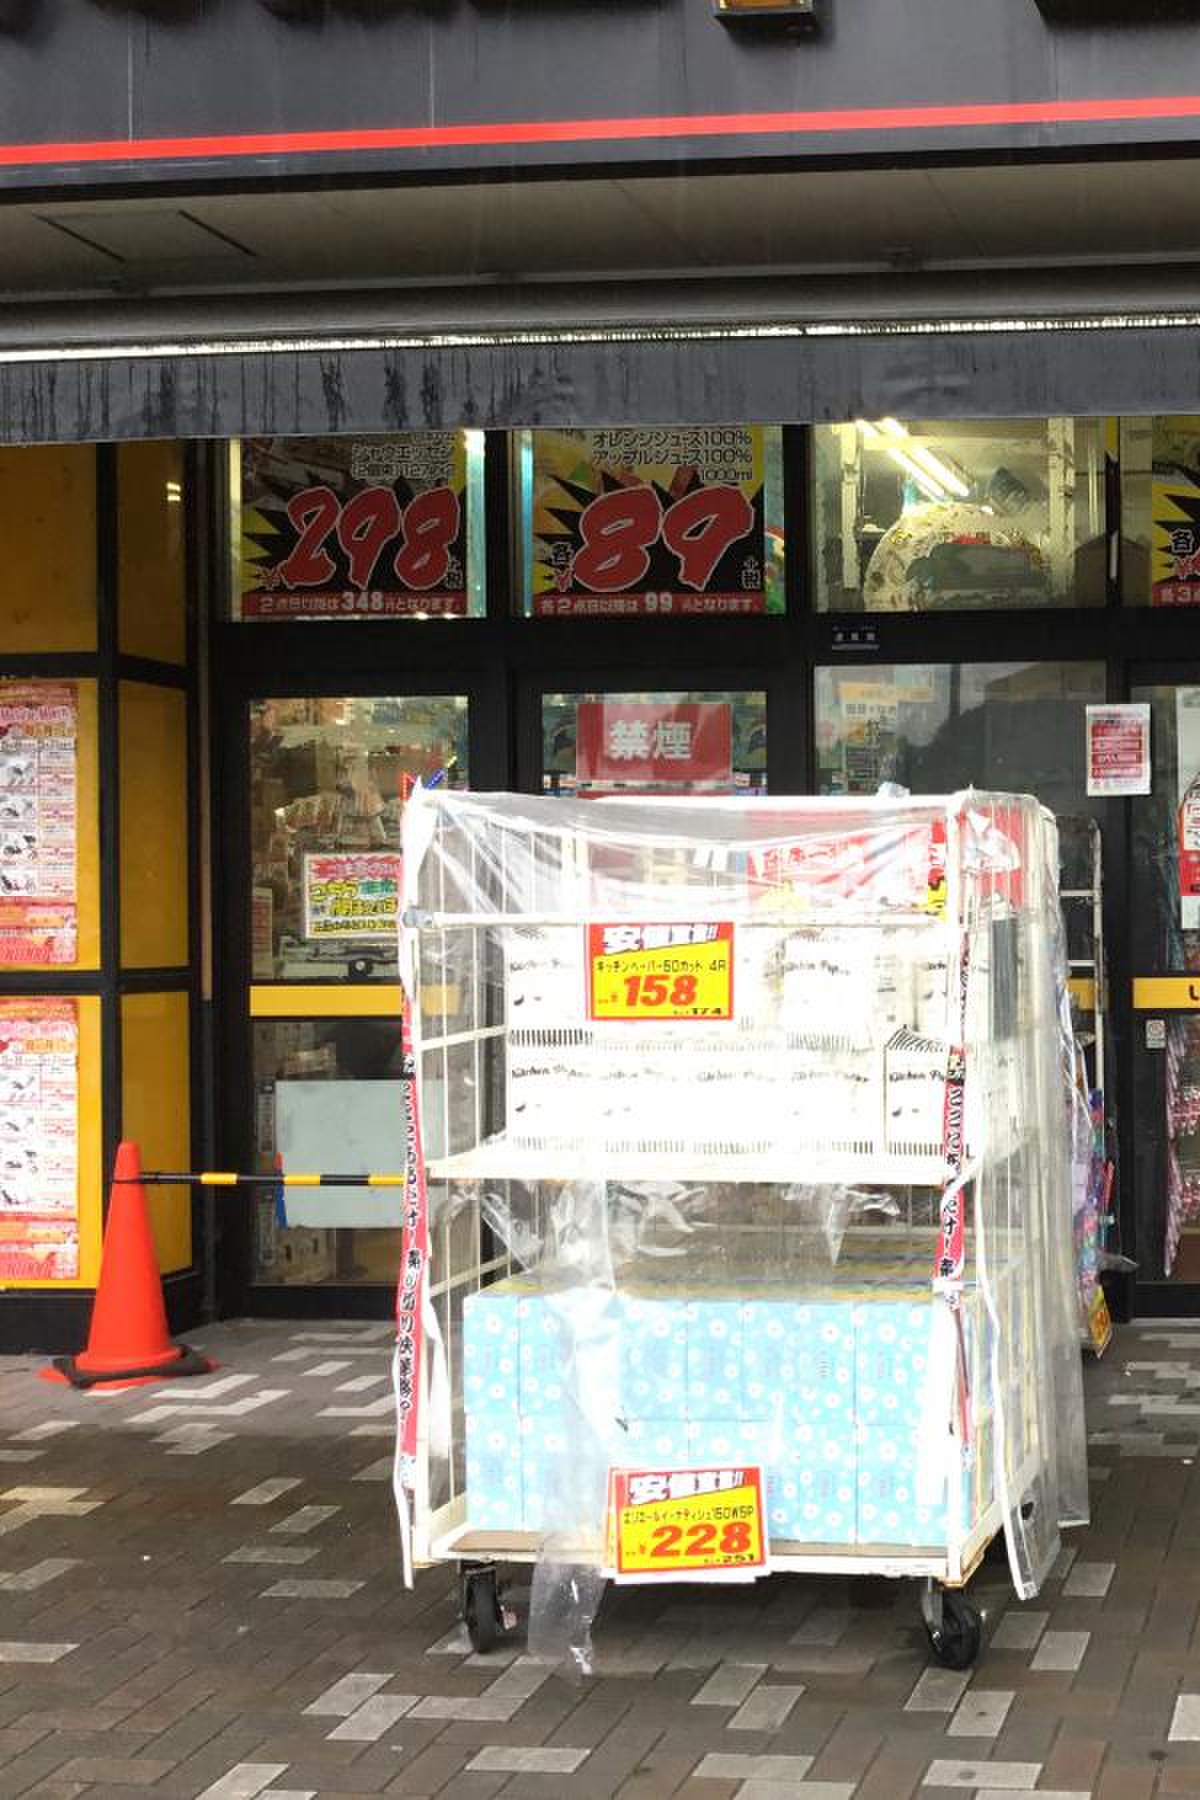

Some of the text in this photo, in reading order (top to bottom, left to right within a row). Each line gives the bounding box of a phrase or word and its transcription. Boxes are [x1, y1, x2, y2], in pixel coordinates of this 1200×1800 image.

[277, 485, 462, 592] 298
[572, 484, 755, 593] 89
[610, 719, 692, 761] 禁煙
[624, 974, 699, 1007] 158
[650, 1520, 753, 1558] 228
